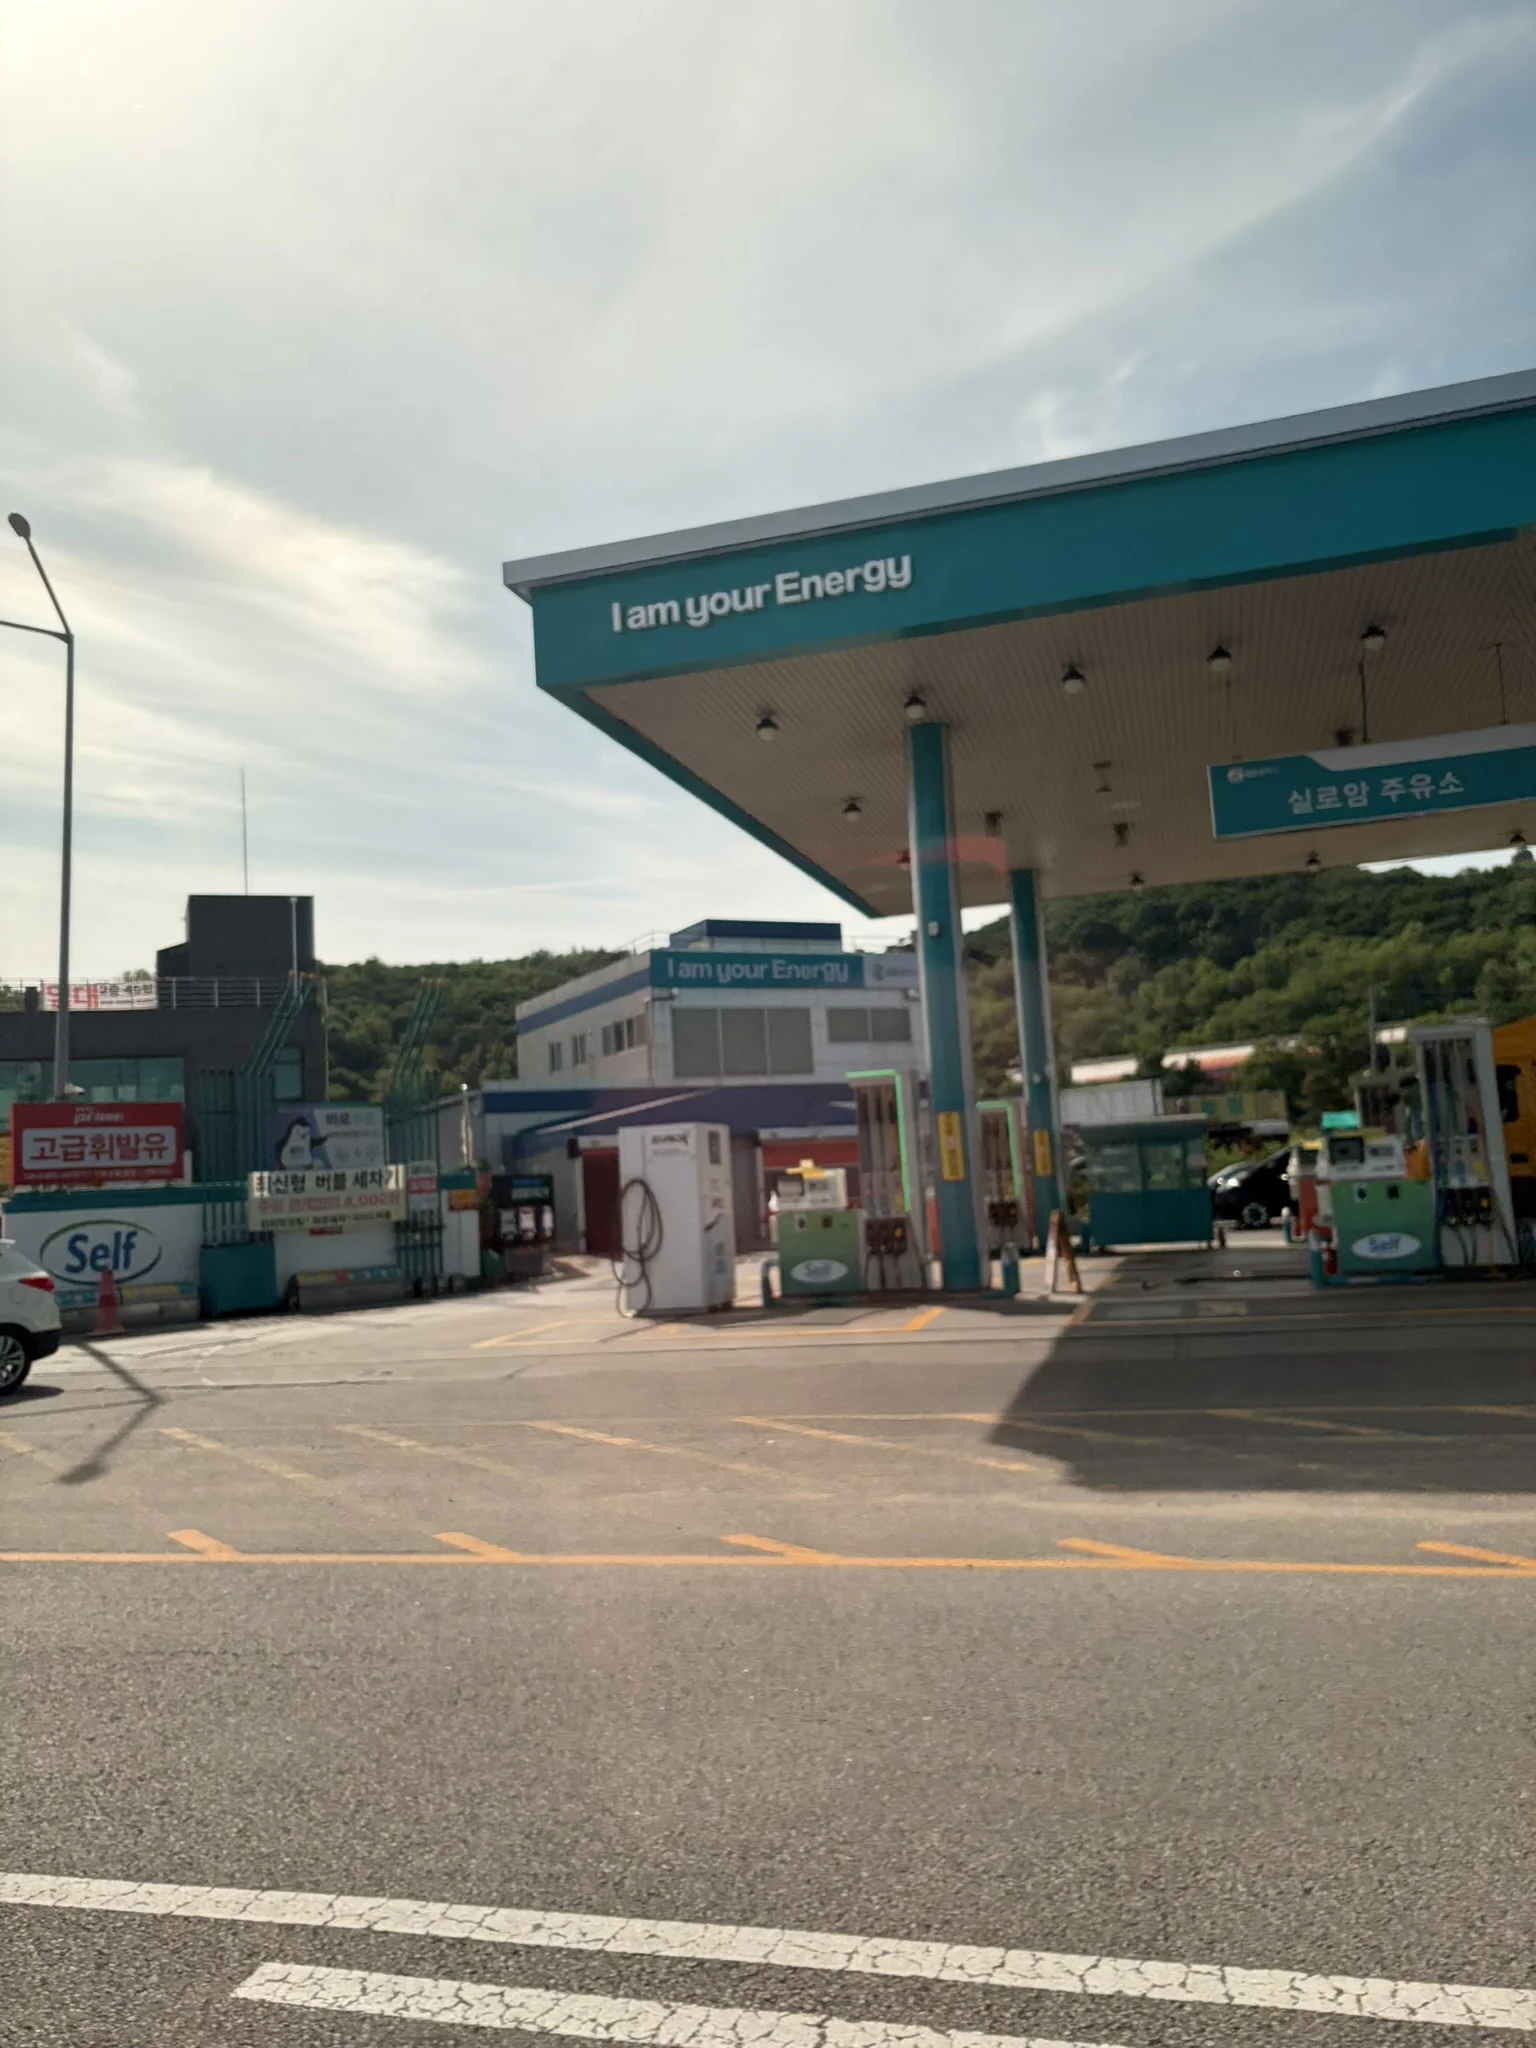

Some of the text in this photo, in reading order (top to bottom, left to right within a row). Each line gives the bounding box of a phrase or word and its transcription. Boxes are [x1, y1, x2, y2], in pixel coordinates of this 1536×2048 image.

[611, 554, 912, 633] I am your Energy
[1287, 771, 1464, 815] 실로암 주유소
[667, 958, 849, 984] I am your Energy
[30, 1131, 169, 1162] 고급휘발유
[256, 1171, 307, 1197] 최신형
[315, 1171, 347, 1193] 버블
[352, 1166, 400, 1191] 세차기
[64, 1229, 138, 1274] Self
[1367, 1236, 1401, 1253] Self
